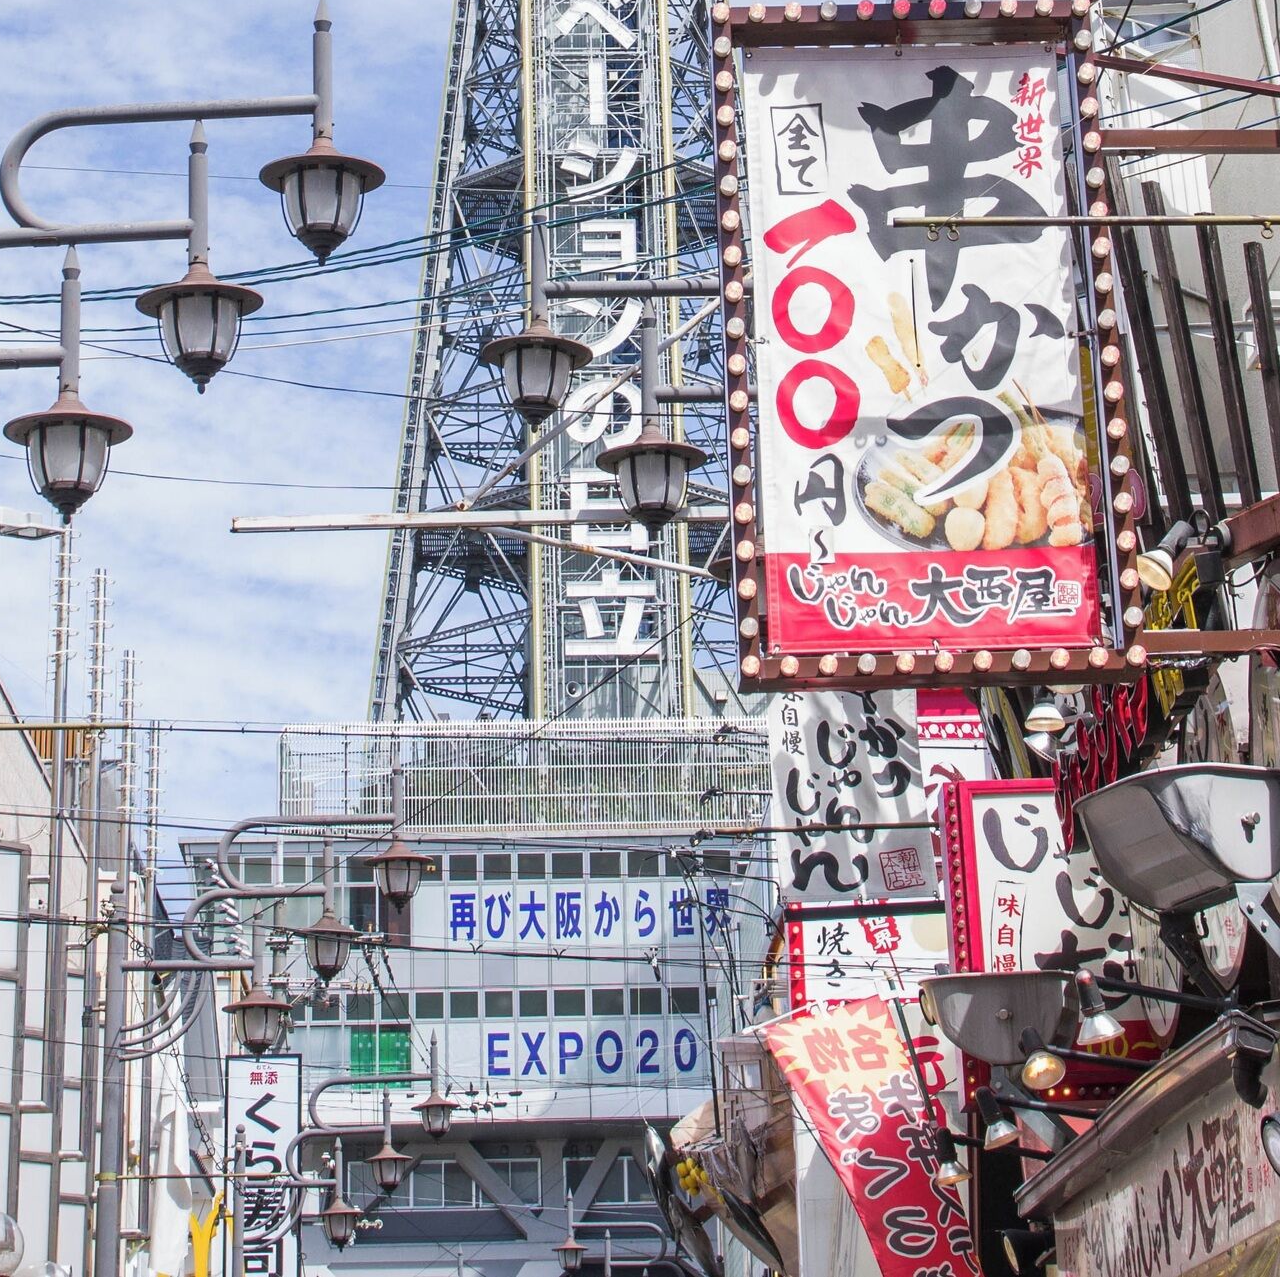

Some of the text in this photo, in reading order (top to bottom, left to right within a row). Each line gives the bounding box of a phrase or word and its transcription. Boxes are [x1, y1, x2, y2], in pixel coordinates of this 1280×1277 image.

[1010, 71, 1046, 180] 新世界
[847, 64, 1062, 500] 串かつ
[909, 565, 1074, 625] 大西屋
[487, 1028, 698, 1076] EXPO20
